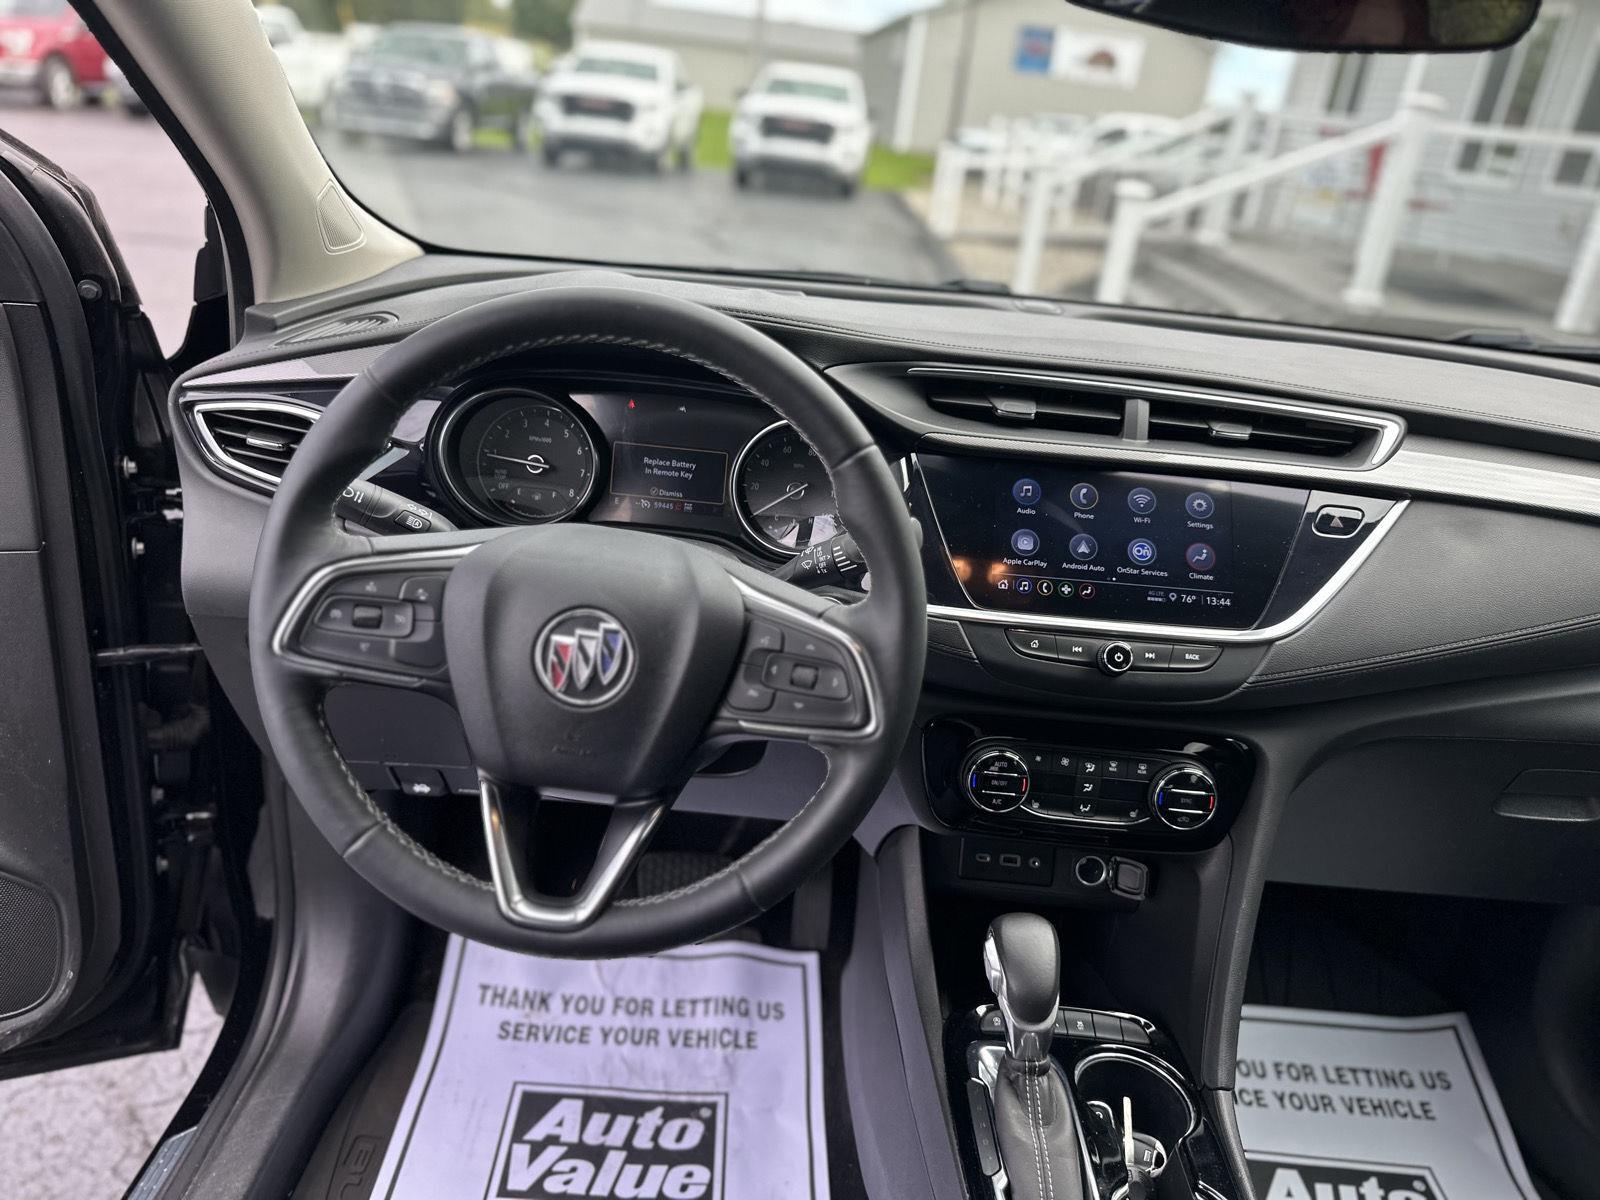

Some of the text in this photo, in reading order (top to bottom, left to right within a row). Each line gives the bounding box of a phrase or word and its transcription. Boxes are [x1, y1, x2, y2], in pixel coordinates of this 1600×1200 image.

[522, 418, 528, 428] 3
[563, 429, 570, 439] 5
[576, 446, 582, 456] 6
[782, 445, 792, 455] 60
[643, 456, 697, 470] Replace Battery
[760, 458, 770, 468] 40
[653, 468, 680, 477] Remote
[680, 471, 693, 481] Key
[750, 482, 760, 491] 20
[568, 488, 575, 498] 8
[658, 489, 683, 498] Dismiss
[654, 501, 674, 510] 59445
[1017, 507, 1036, 516] Audio
[1073, 511, 1094, 520] Phone
[1133, 516, 1151, 524] Wi-Fi
[1187, 520, 1214, 530] Settings
[1134, 546, 1151, 557] On
[1003, 557, 1048, 569] Apple CarPlay
[1061, 562, 1105, 572] Android Auto
[1116, 566, 1168, 577] OnStar Services
[1188, 571, 1214, 581] Climate
[1206, 596, 1232, 607] 13:44
[1185, 653, 1200, 661] BACK
[478, 983, 785, 1020] THANK YOU FOR LETTING US
[497, 1020, 758, 1050] SERVICE YOUR VEHICLE
[1235, 1059, 1452, 1091] OU FOR LETTING US
[1275, 1091, 1336, 1114] YOUR
[1344, 1096, 1437, 1121] VEHICLE
[522, 1098, 707, 1151] Auto
[506, 1143, 711, 1199] Value
